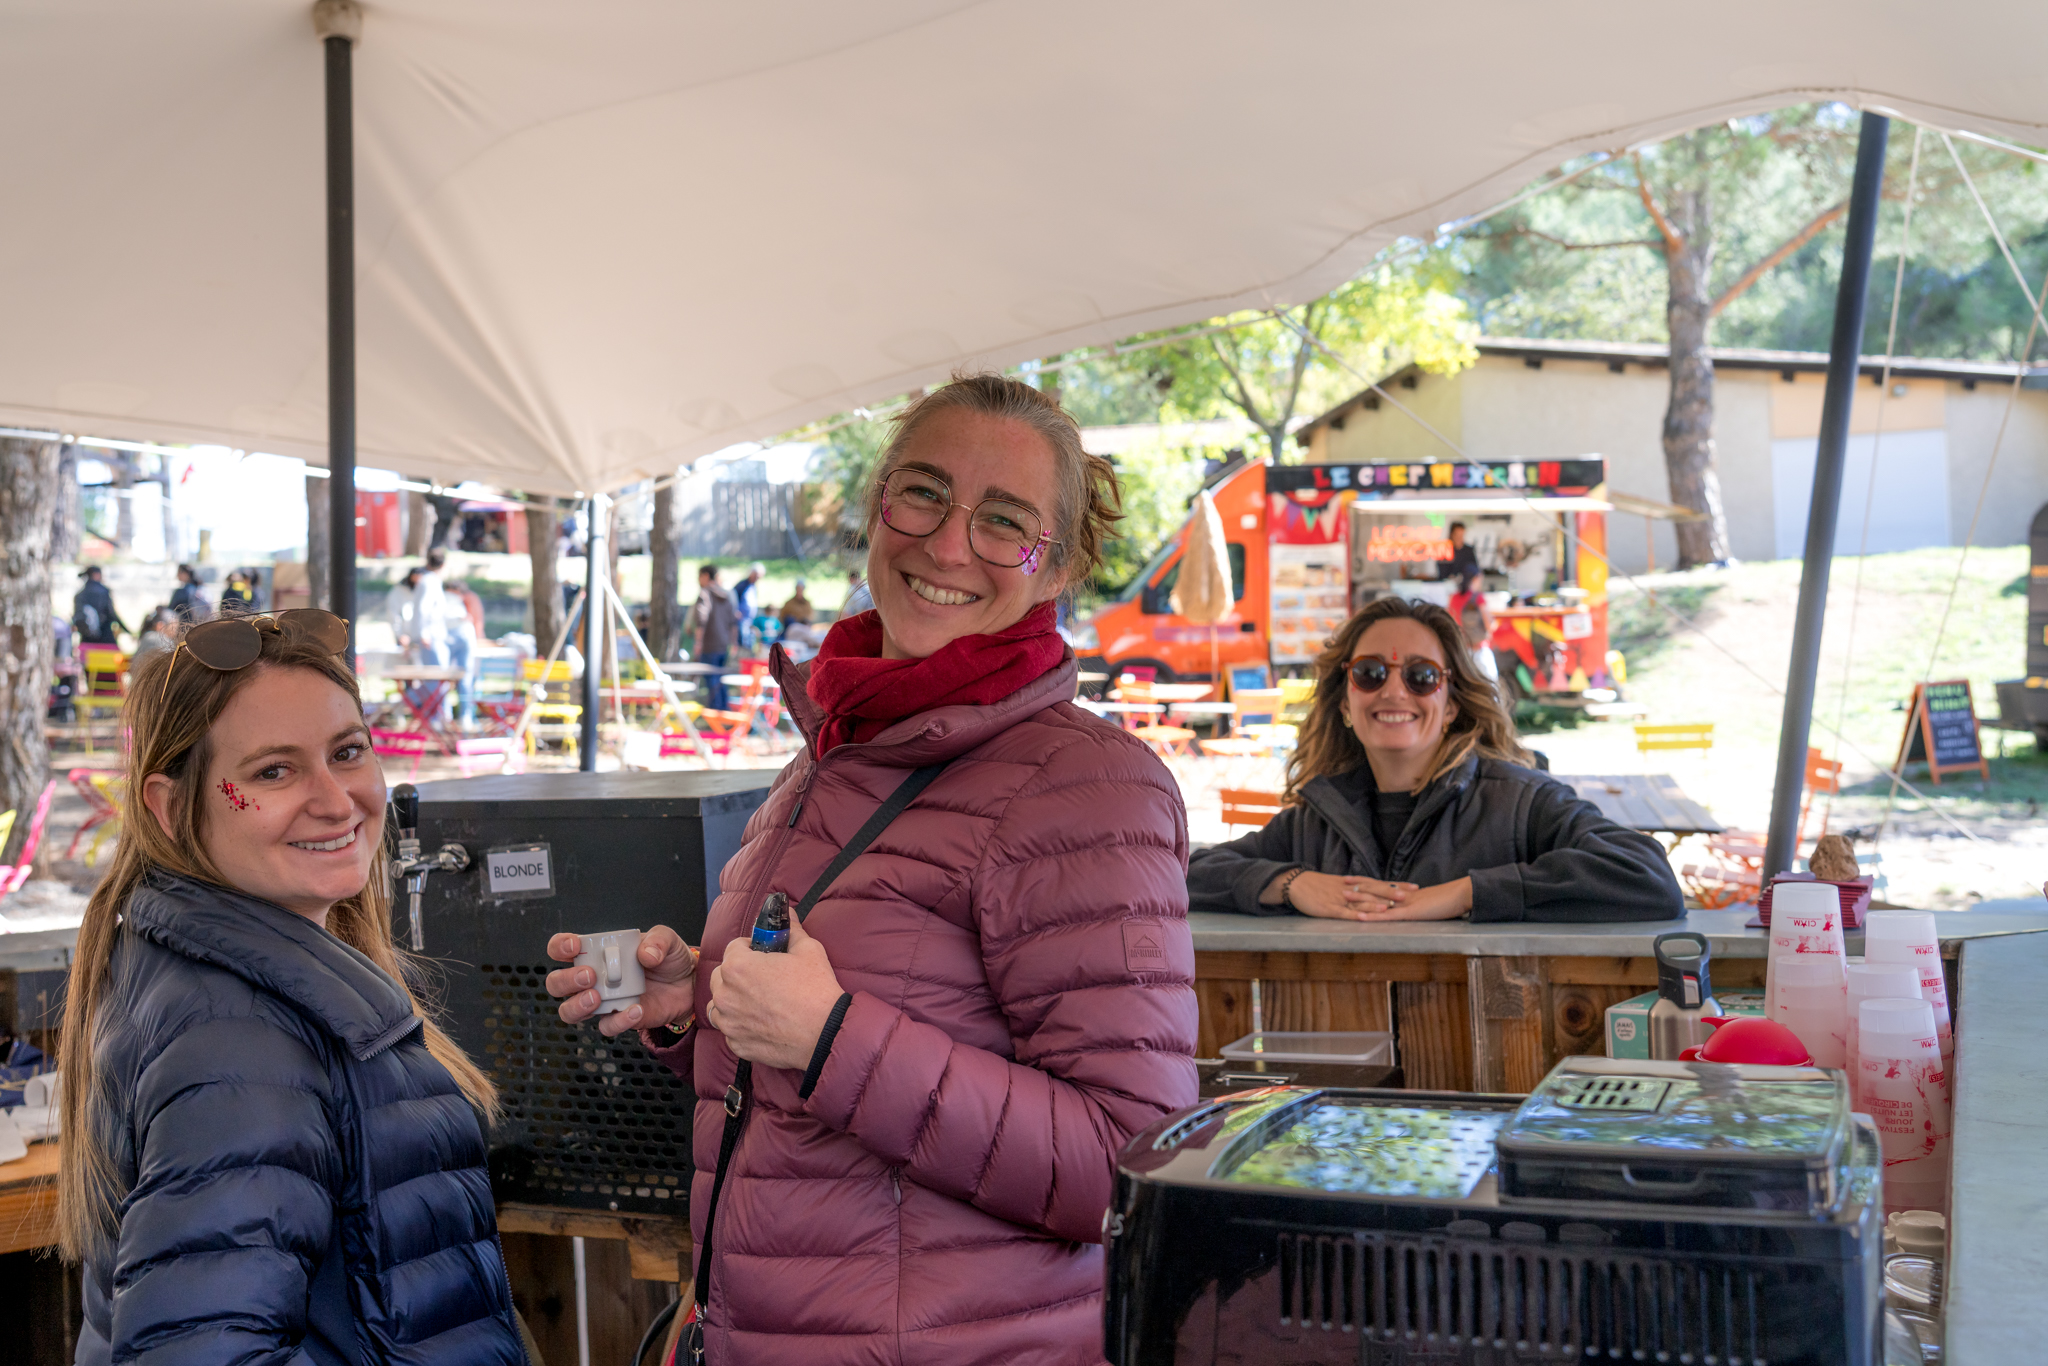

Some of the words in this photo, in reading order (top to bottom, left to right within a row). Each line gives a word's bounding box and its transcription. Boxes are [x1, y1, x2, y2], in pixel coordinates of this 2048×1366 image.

[1312, 467, 1351, 489] LE
[1357, 465, 1426, 487] CHEF
[1429, 461, 1562, 487] MEXICAIN
[494, 862, 544, 879] BLONDE
[1877, 1126, 1915, 1134] FESTIVA
